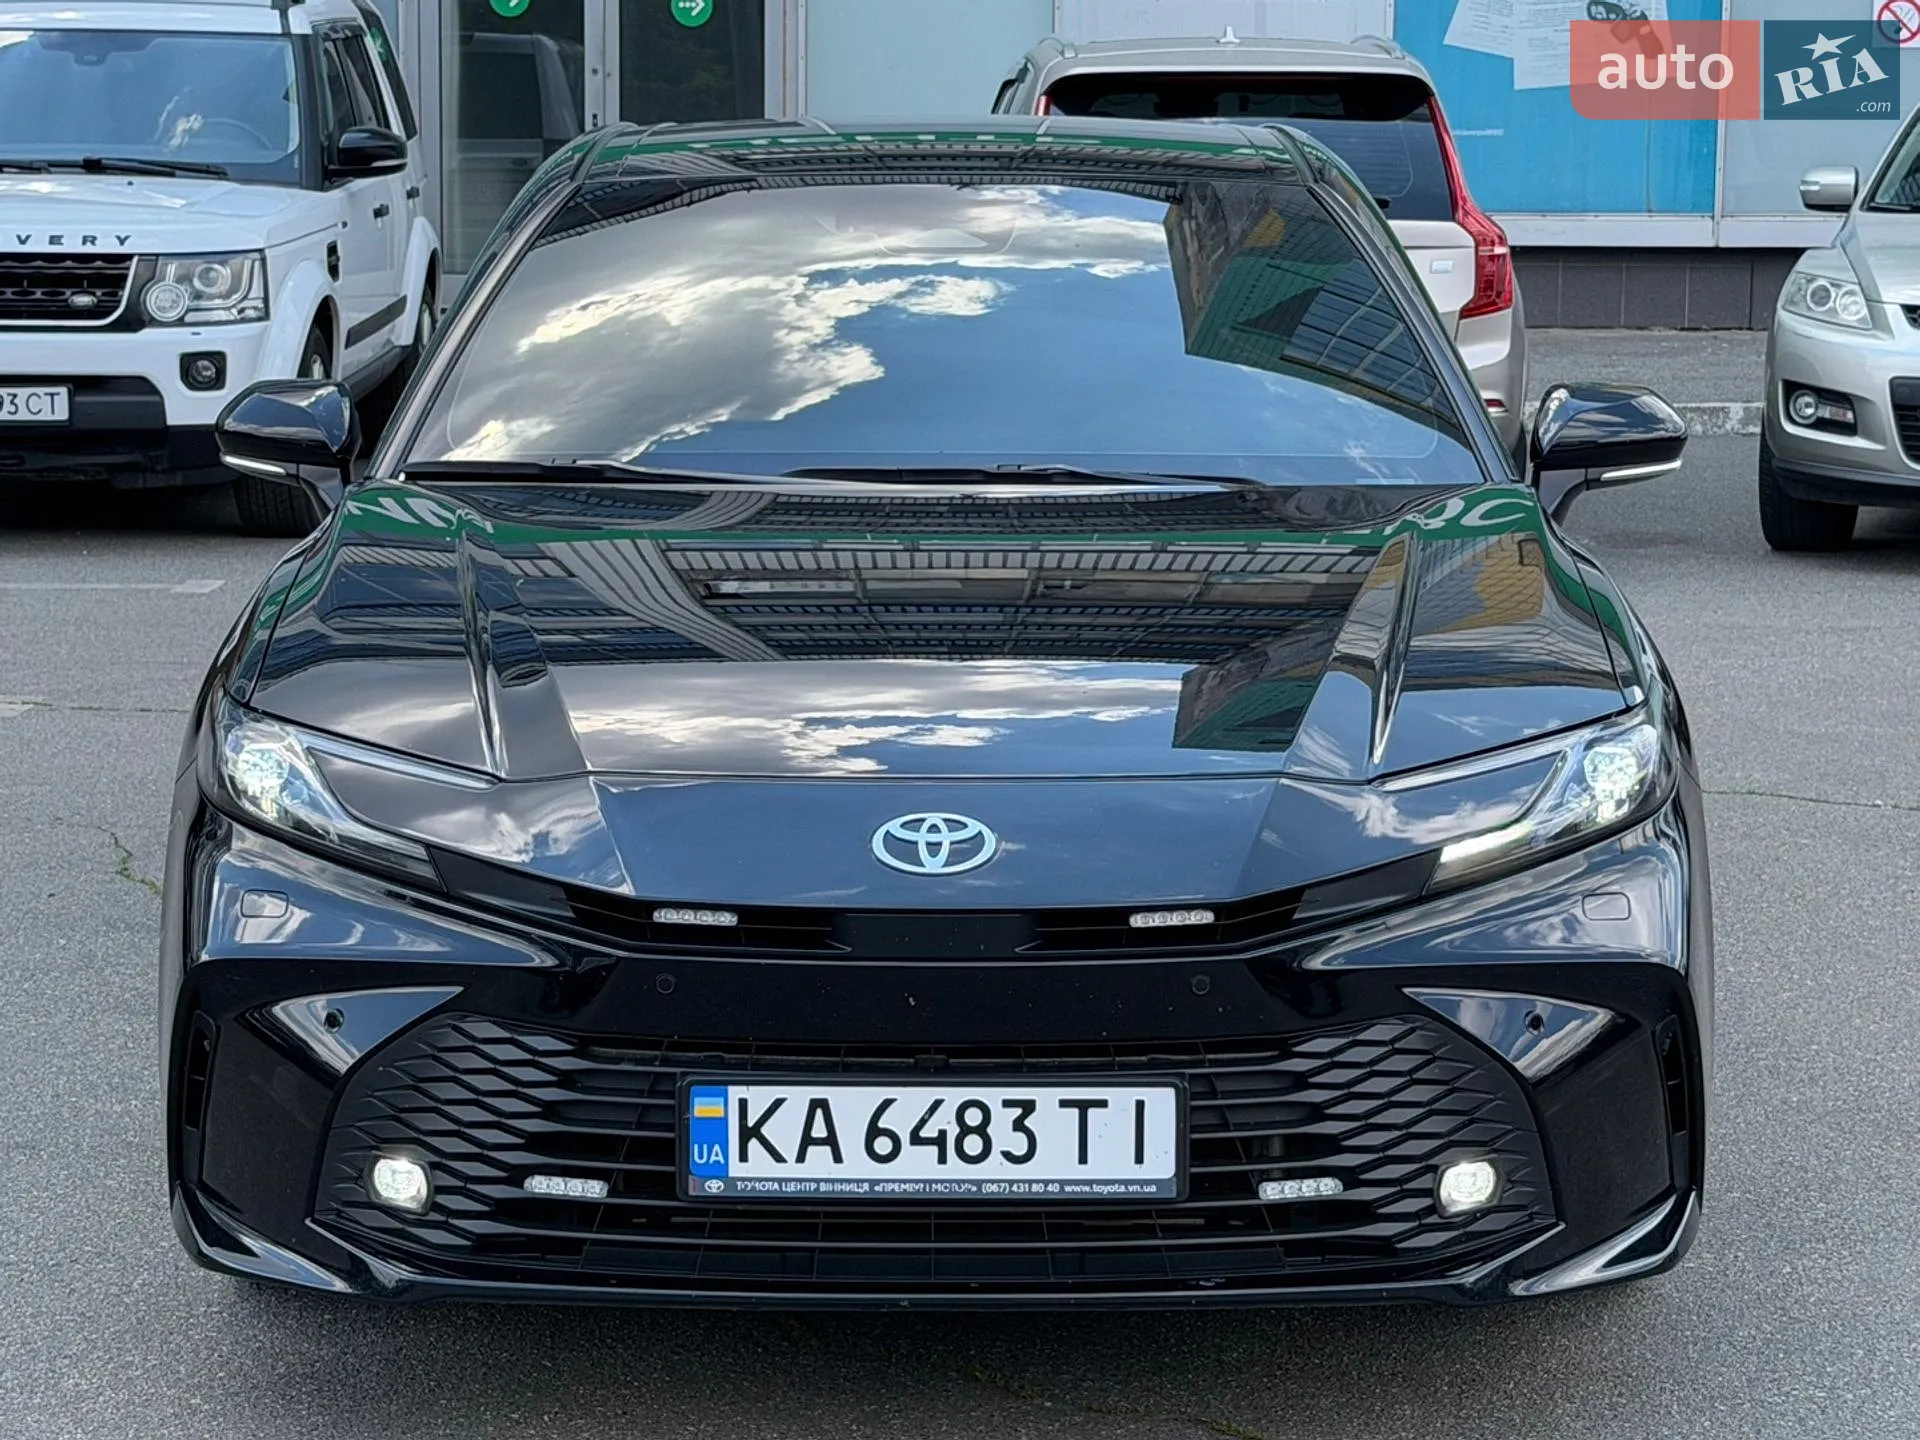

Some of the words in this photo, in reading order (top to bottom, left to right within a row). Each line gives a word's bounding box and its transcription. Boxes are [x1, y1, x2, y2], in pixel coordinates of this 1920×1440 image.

[16, 234, 132, 247] VERY
[26, 392, 61, 416] CT
[738, 1097, 845, 1164] KA
[864, 1097, 1038, 1165] 6483
[693, 1143, 725, 1164] UA
[782, 1181, 818, 1192] ЦЕНТР
[981, 1183, 1010, 1194] (067)
[1011, 1183, 1029, 1193] 431
[1031, 1183, 1045, 1193] 80
[1046, 1183, 1060, 1193] 40
[1063, 1184, 1157, 1195] www.toyota.vn.ua
